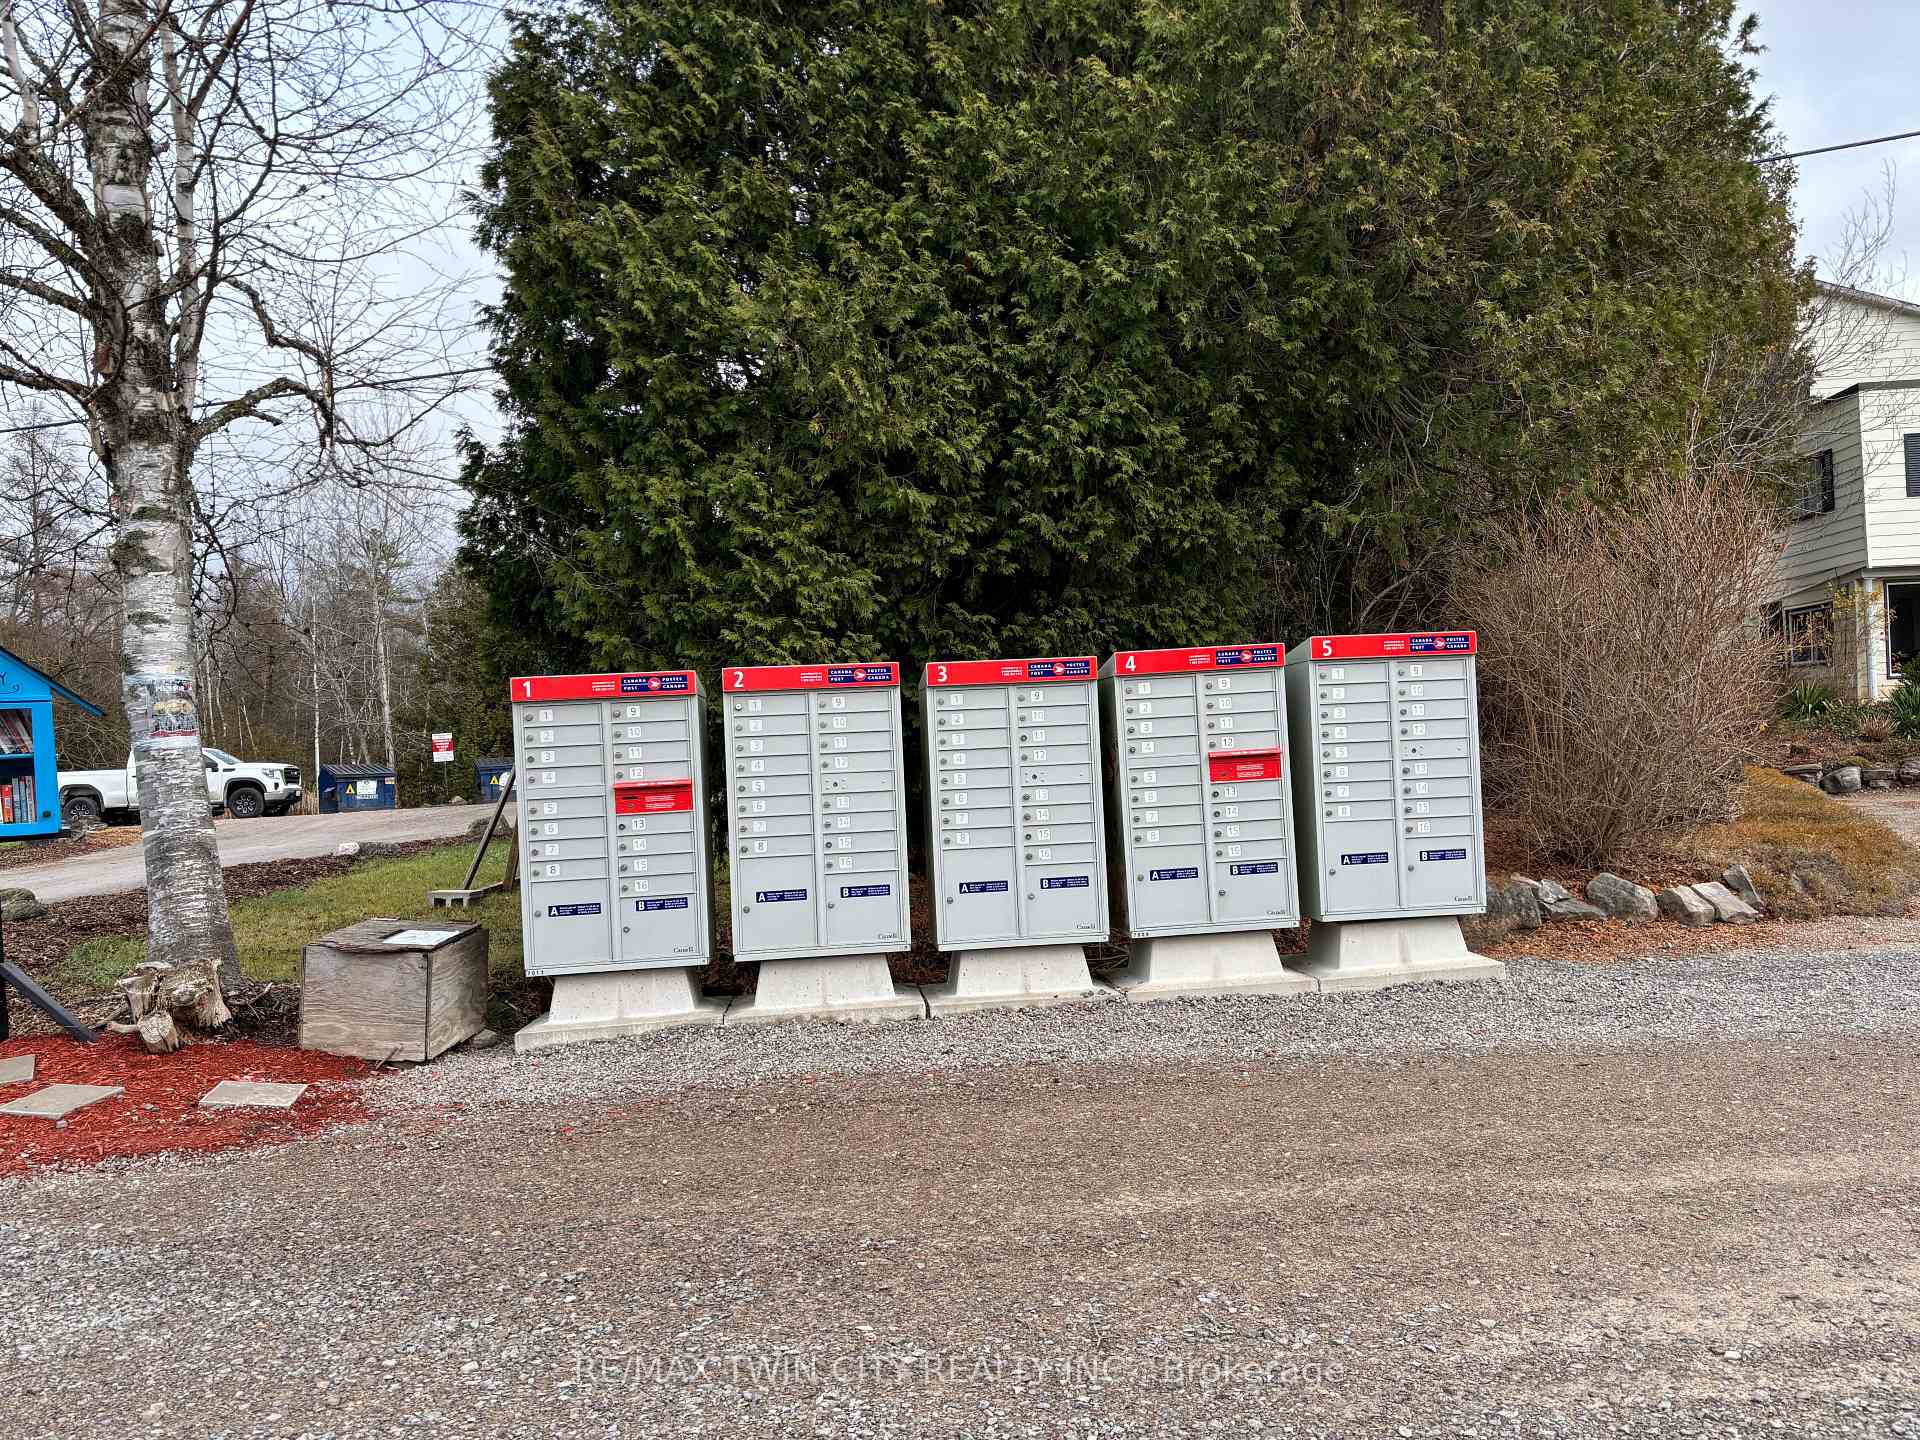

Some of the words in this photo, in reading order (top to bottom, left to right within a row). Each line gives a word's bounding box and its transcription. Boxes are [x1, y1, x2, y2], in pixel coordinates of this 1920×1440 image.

[1323, 640, 1333, 656] 5
[1125, 655, 1136, 672] 4
[937, 665, 948, 682] 3
[733, 671, 744, 688] 2
[523, 681, 531, 697] 1
[630, 728, 640, 736] 10
[1223, 738, 1233, 747] 12
[632, 769, 642, 777] 12
[634, 820, 645, 828] 13
[1040, 830, 1049, 838] 15
[1343, 856, 1351, 864] A
[1421, 852, 1428, 860] B
[1232, 866, 1238, 874] B
[1152, 871, 1159, 880] A
[637, 881, 648, 889] 16
[961, 884, 969, 893] A
[1042, 880, 1049, 888] B
[842, 888, 849, 897] B
[758, 893, 766, 902] A
[638, 901, 645, 910] B
[551, 906, 559, 916] A
